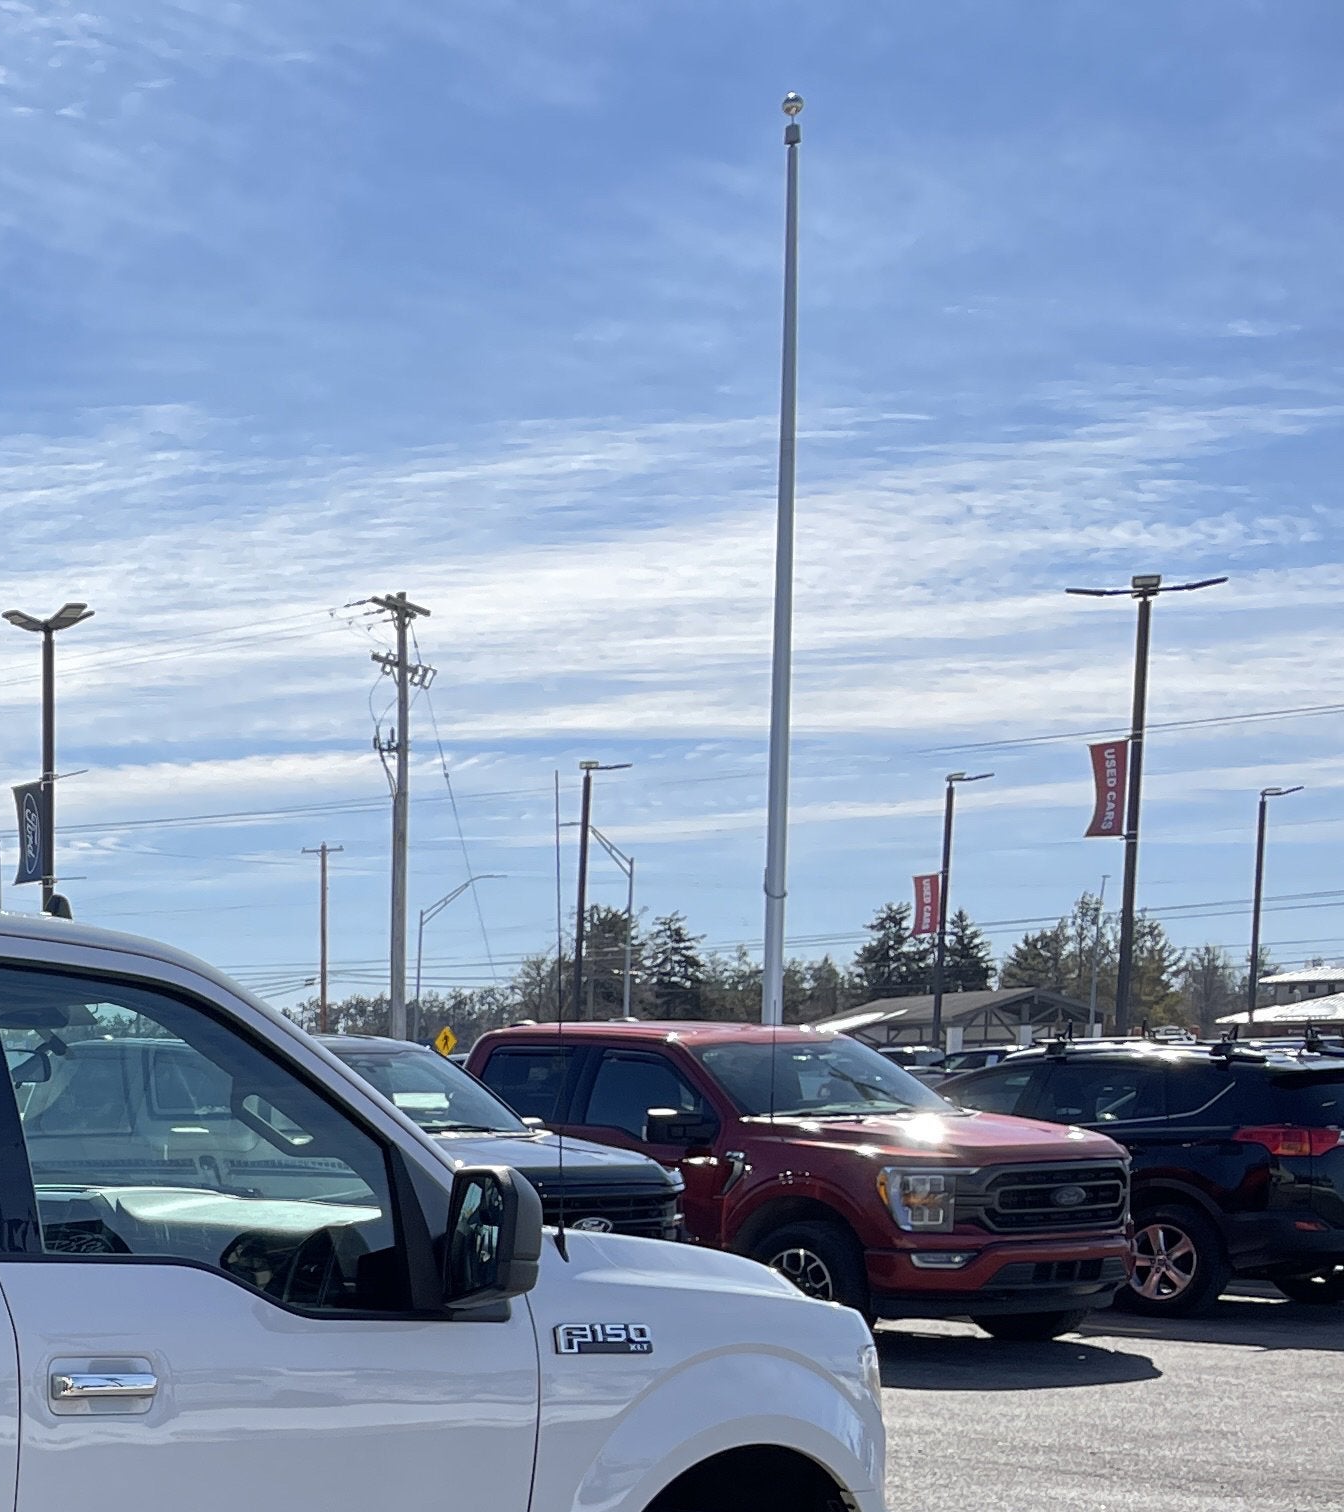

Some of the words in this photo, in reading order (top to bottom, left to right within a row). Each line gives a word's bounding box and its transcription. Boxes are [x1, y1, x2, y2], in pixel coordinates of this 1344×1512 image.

[1103, 748, 1117, 788] USED
[1100, 791, 1117, 830] CARS
[25, 808, 39, 858] Ford
[629, 1342, 649, 1351] XLT
